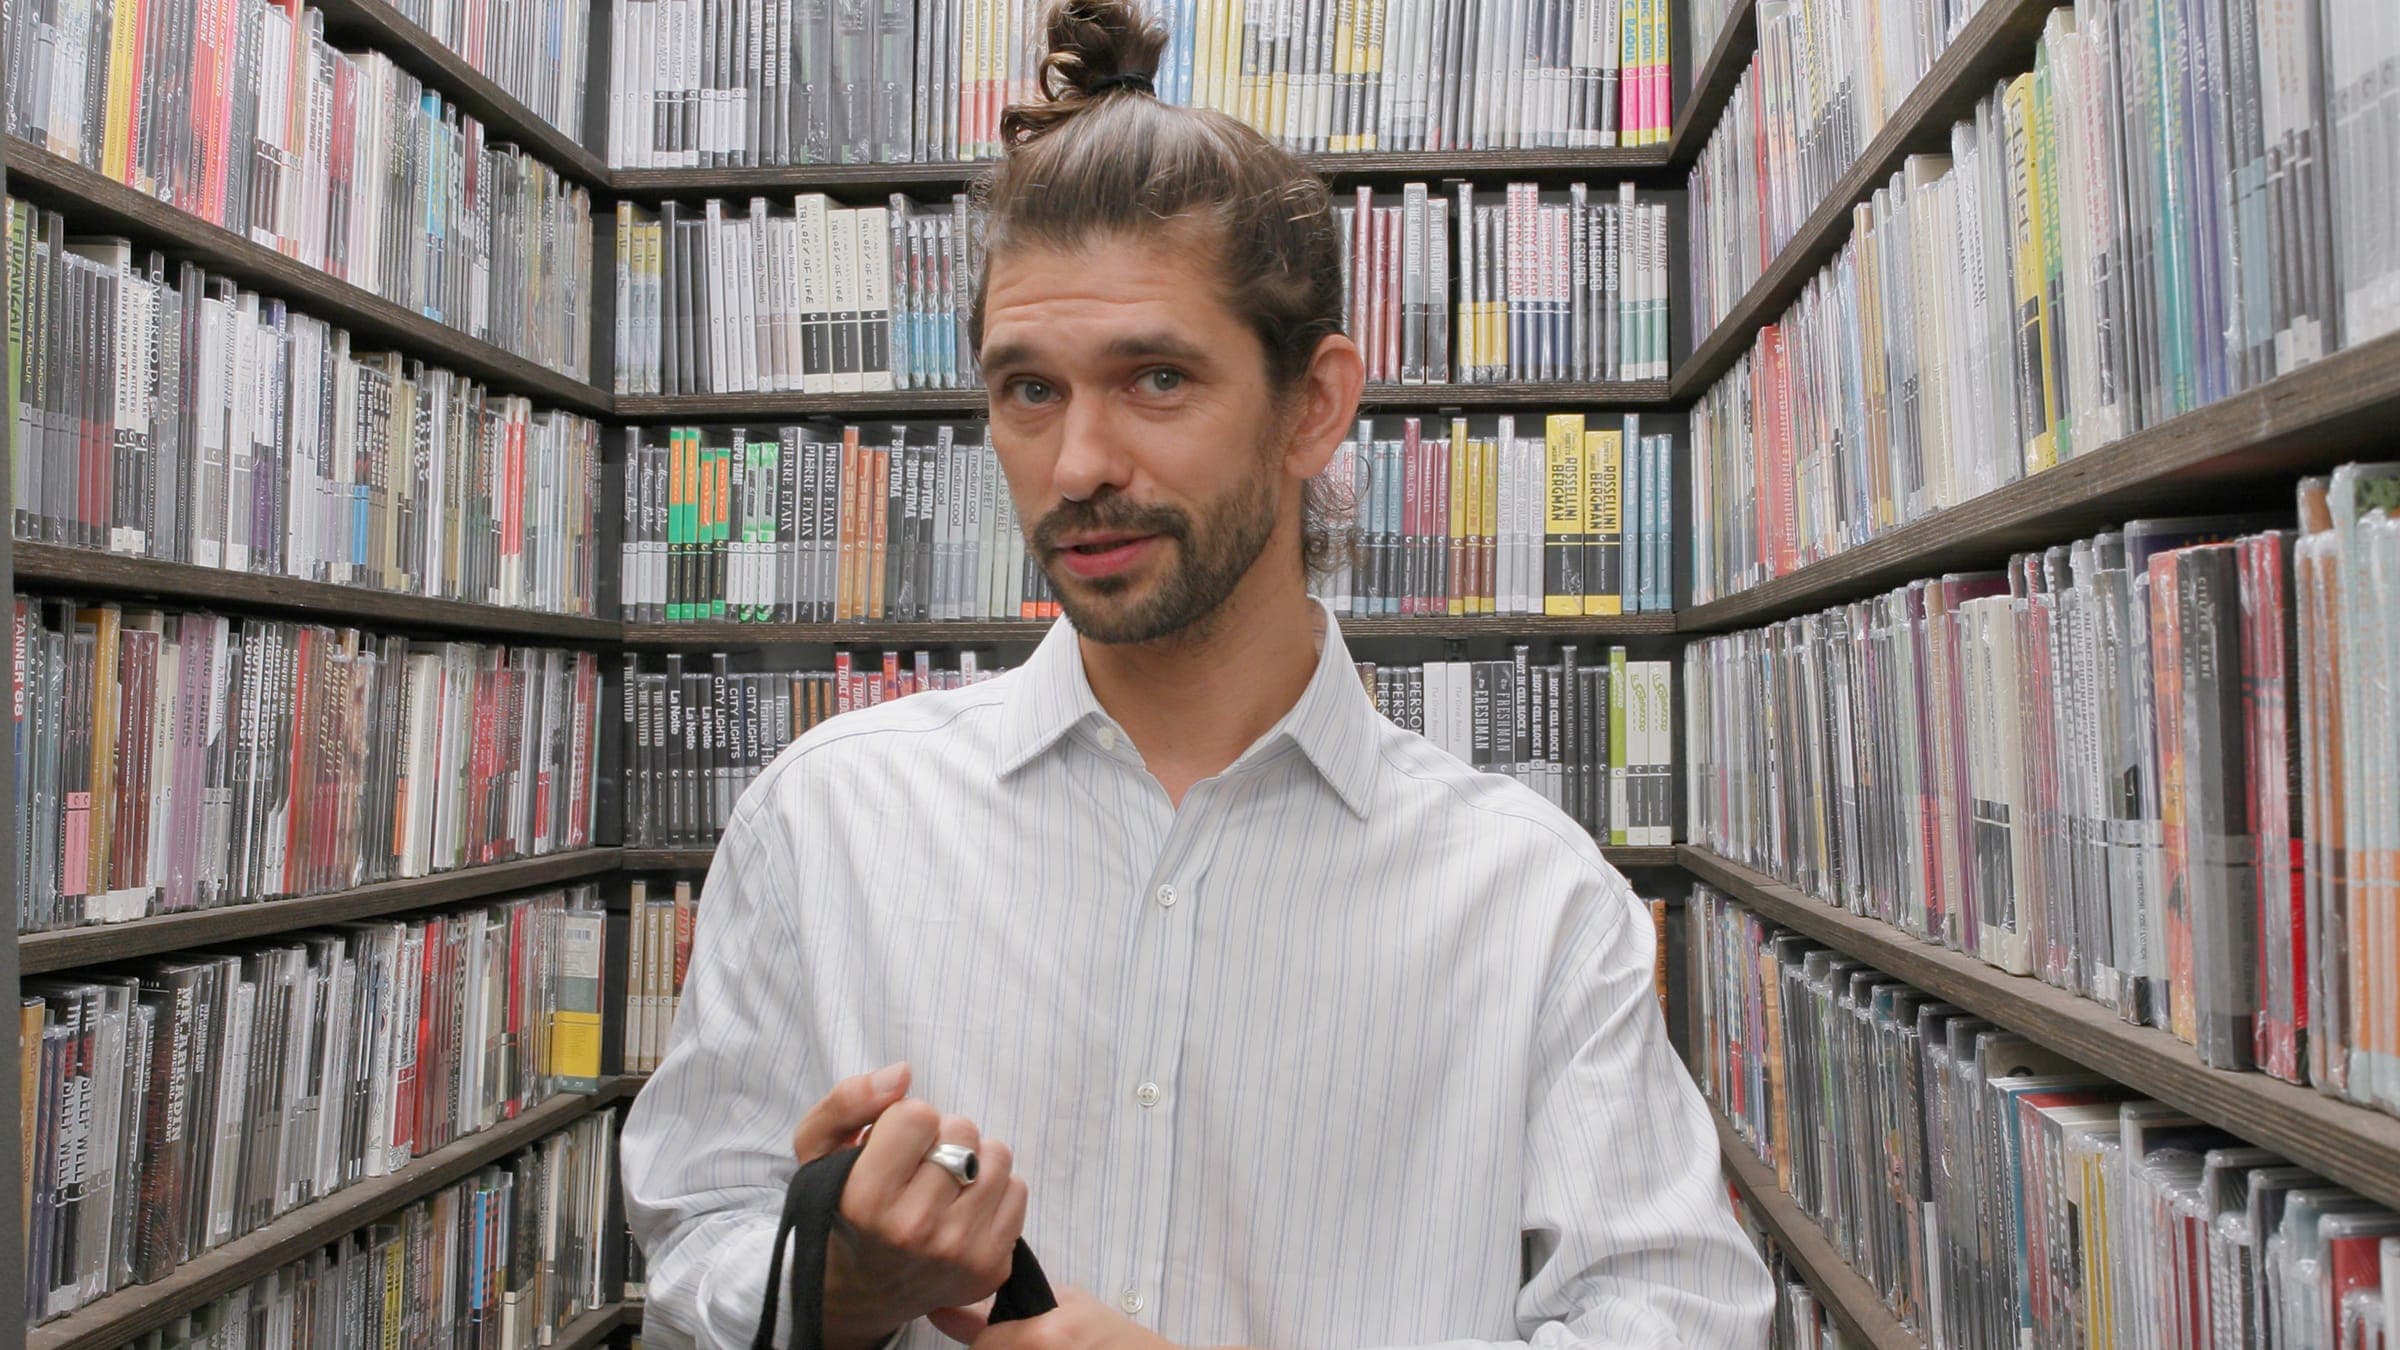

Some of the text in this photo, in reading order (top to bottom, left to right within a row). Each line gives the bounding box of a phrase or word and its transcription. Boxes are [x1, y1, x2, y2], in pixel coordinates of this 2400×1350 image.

[766, 3, 776, 87] THE WAR ROOM
[780, 52, 791, 85] ROOM
[1625, 18, 1636, 63] RAOUL
[799, 204, 814, 305] TRILOGY OF LIFE
[1408, 192, 1421, 277] ON THE WATERFRONT
[1431, 209, 1444, 295] ON THE WATERFRONT
[1573, 217, 1586, 240] MAN
[10, 228, 25, 345] FIDANZATI
[29, 229, 38, 299] HIROSHIMA
[755, 213, 766, 304] Sunday Bloody Sunday
[831, 218, 843, 303] TRILOGY OF LIFE
[861, 217, 874, 302] TRILOGY OF LIFE
[1573, 242, 1586, 286] ESCAPED
[39, 261, 49, 326] HIROSHIMA
[149, 270, 162, 368] UMBERTO
[119, 287, 128, 359] HONEYMOON
[25, 335, 33, 384] AMOUR
[119, 364, 127, 412] KILLERS
[733, 437, 744, 485] REPO MAN
[781, 439, 794, 531] PIERRE ETAIX
[890, 466, 902, 498] YUMA
[937, 436, 947, 505] medium cool
[969, 454, 979, 524] medium cool
[985, 460, 994, 471] IS
[1565, 457, 1577, 521] ROSSELLINI
[802, 445, 816, 537] PIERRE ETAIX
[823, 445, 837, 537] PIERRE ETAIX
[905, 486, 917, 519] YUMA
[952, 457, 962, 527] medium cool
[984, 474, 994, 509] SWEET
[997, 499, 1008, 534] SWEET
[1551, 464, 1564, 521] BERGMAN
[1590, 472, 1603, 530] BERGMAN
[1603, 465, 1617, 530] ROSSELLINI
[2197, 576, 2210, 680] CITIZEN KANE
[14, 614, 26, 717] TANNER '88
[250, 637, 261, 686] YOUTH
[280, 648, 289, 688] CASQUE
[290, 649, 298, 688] CASQUE
[624, 665, 634, 681] THE
[1516, 655, 1526, 675] RIOT
[1516, 676, 1526, 686] IN
[1532, 673, 1542, 694] RIOT
[238, 635, 254, 749] YOUTH BEAST
[258, 635, 272, 749] FIGHTING ELEGY
[268, 635, 282, 748] FIGHTING ELEGY
[318, 642, 334, 752] NIGHT CITY
[654, 690, 663, 706] THE
[670, 689, 681, 735] La Notte
[715, 676, 725, 748] CITY LIGHTS
[1474, 690, 1489, 749] FRESHMAN
[1516, 686, 1526, 704] CELL
[1516, 705, 1526, 729] BLOCK
[1532, 695, 1542, 704] IN
[1532, 705, 1542, 723] CELL
[324, 667, 340, 776] NIGHT CITY
[335, 667, 349, 775] NIGHT CITY
[686, 707, 696, 750] La Notte
[702, 706, 712, 749] La Notte
[729, 687, 740, 759] CITY LIGHTS
[746, 686, 757, 758] CITY LIGHTS
[1496, 692, 1511, 751] FRESHMAN
[1532, 724, 1542, 749] BLOCK
[66, 1003, 82, 1036] THE
[84, 1000, 97, 1033] THE
[168, 1021, 180, 1100] CONFIDENTIAL
[170, 1033, 190, 1143] ARKADIN
[60, 1084, 75, 1135] SLEEP
[77, 1079, 92, 1131] SLEEP
[165, 1103, 175, 1143] REPORT
[57, 1140, 72, 1188] WELL
[73, 1135, 88, 1183] WELL
